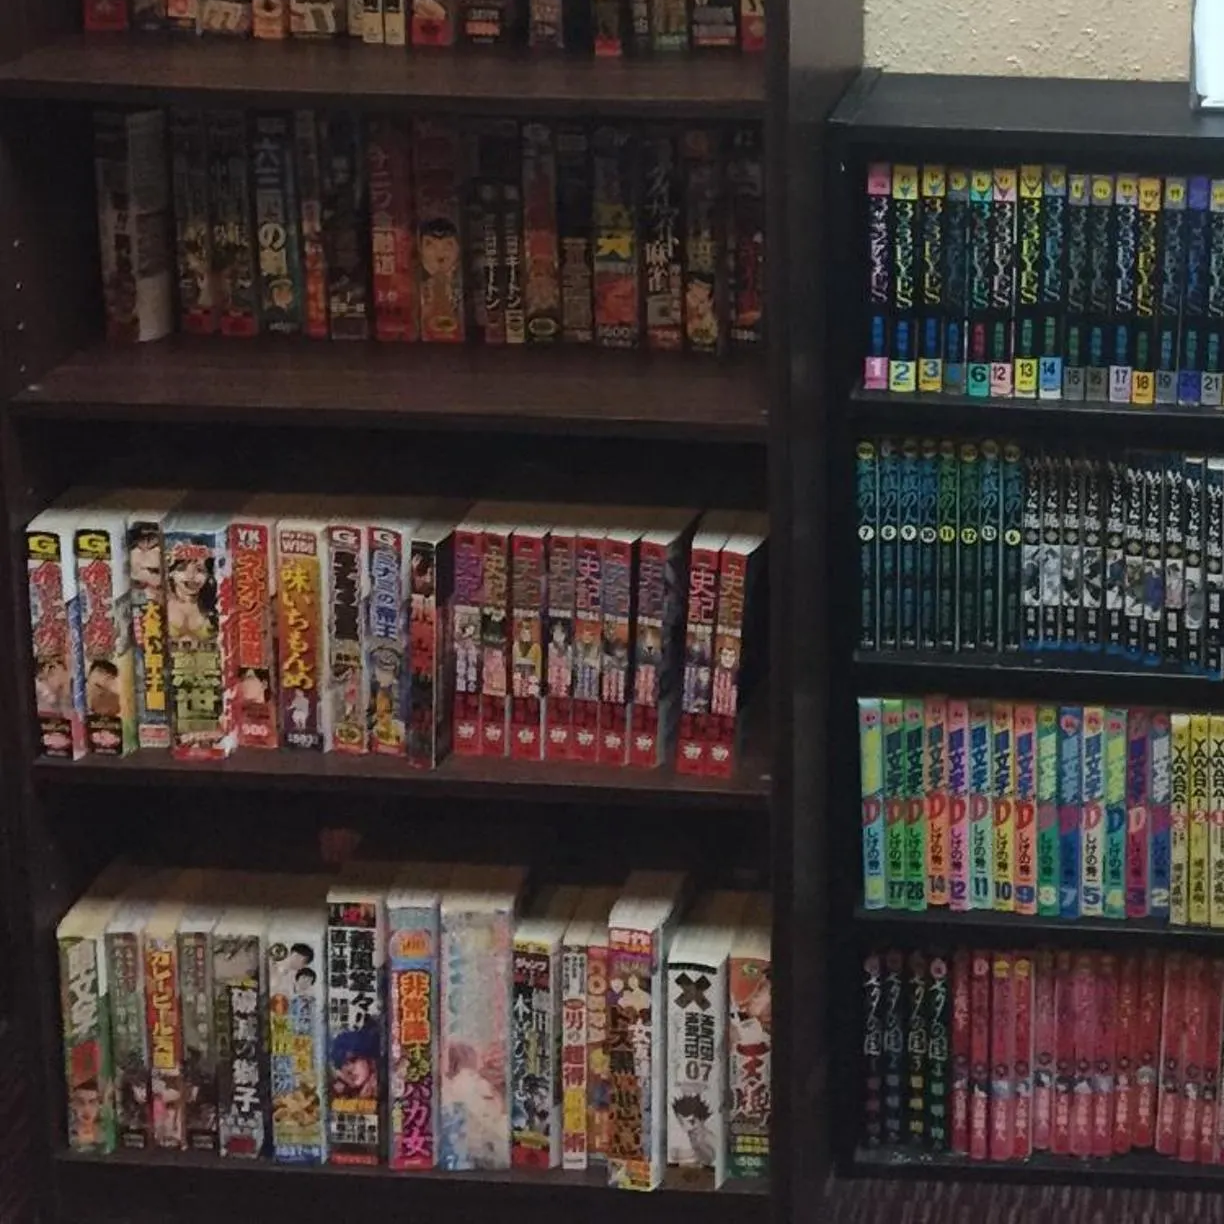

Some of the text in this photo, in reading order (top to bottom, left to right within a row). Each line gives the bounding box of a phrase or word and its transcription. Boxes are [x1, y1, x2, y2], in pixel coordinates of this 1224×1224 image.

[281, 560, 313, 690] 味いちもんめ
